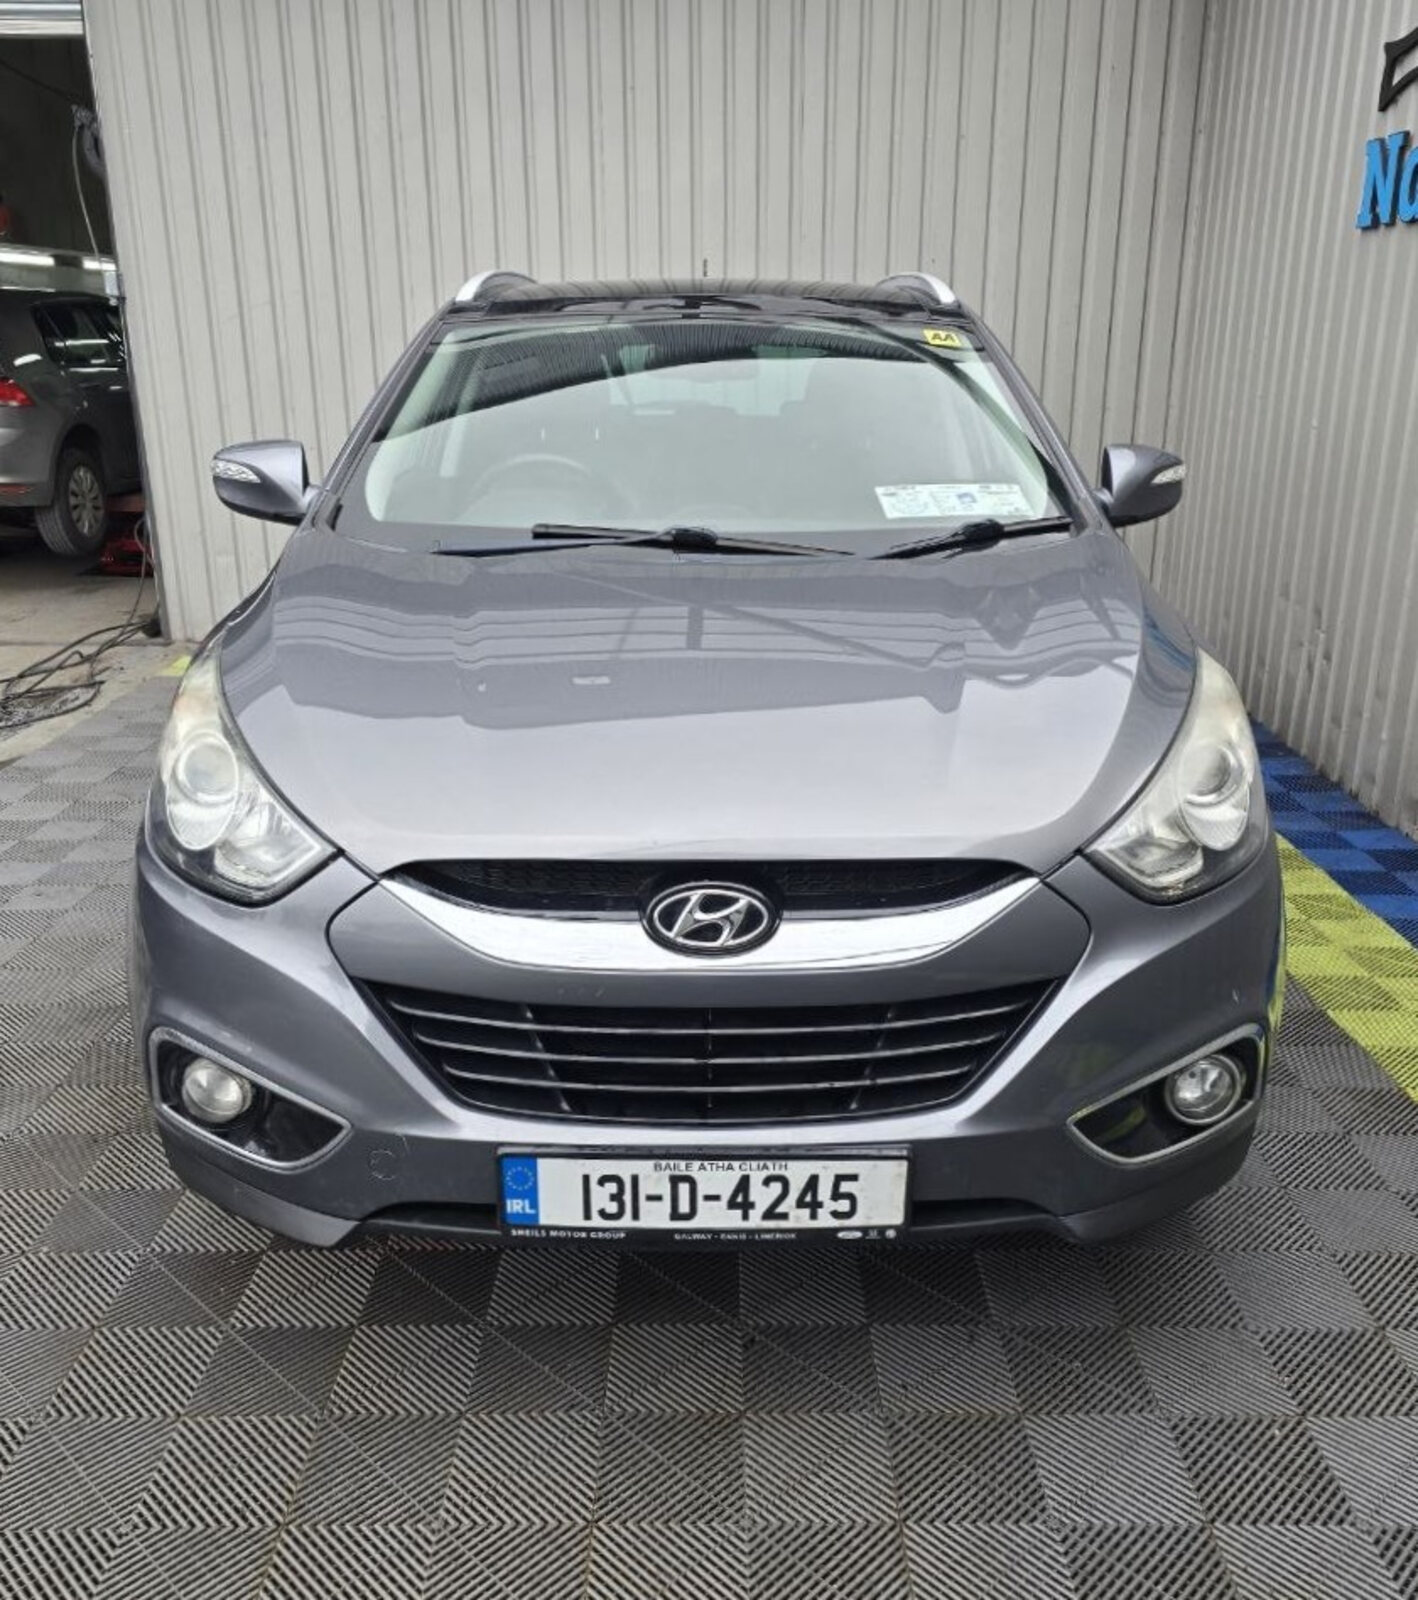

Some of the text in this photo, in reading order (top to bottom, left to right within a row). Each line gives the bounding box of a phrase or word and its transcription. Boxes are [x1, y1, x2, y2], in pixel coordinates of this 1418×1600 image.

[930, 332, 956, 342] AA
[653, 1162, 788, 1172] BAILE ATHA CLIATH
[582, 1173, 859, 1222] 131-D-4245
[506, 1199, 536, 1214] IRL
[550, 1230, 586, 1238] MOTOR
[590, 1231, 627, 1239] GROUP
